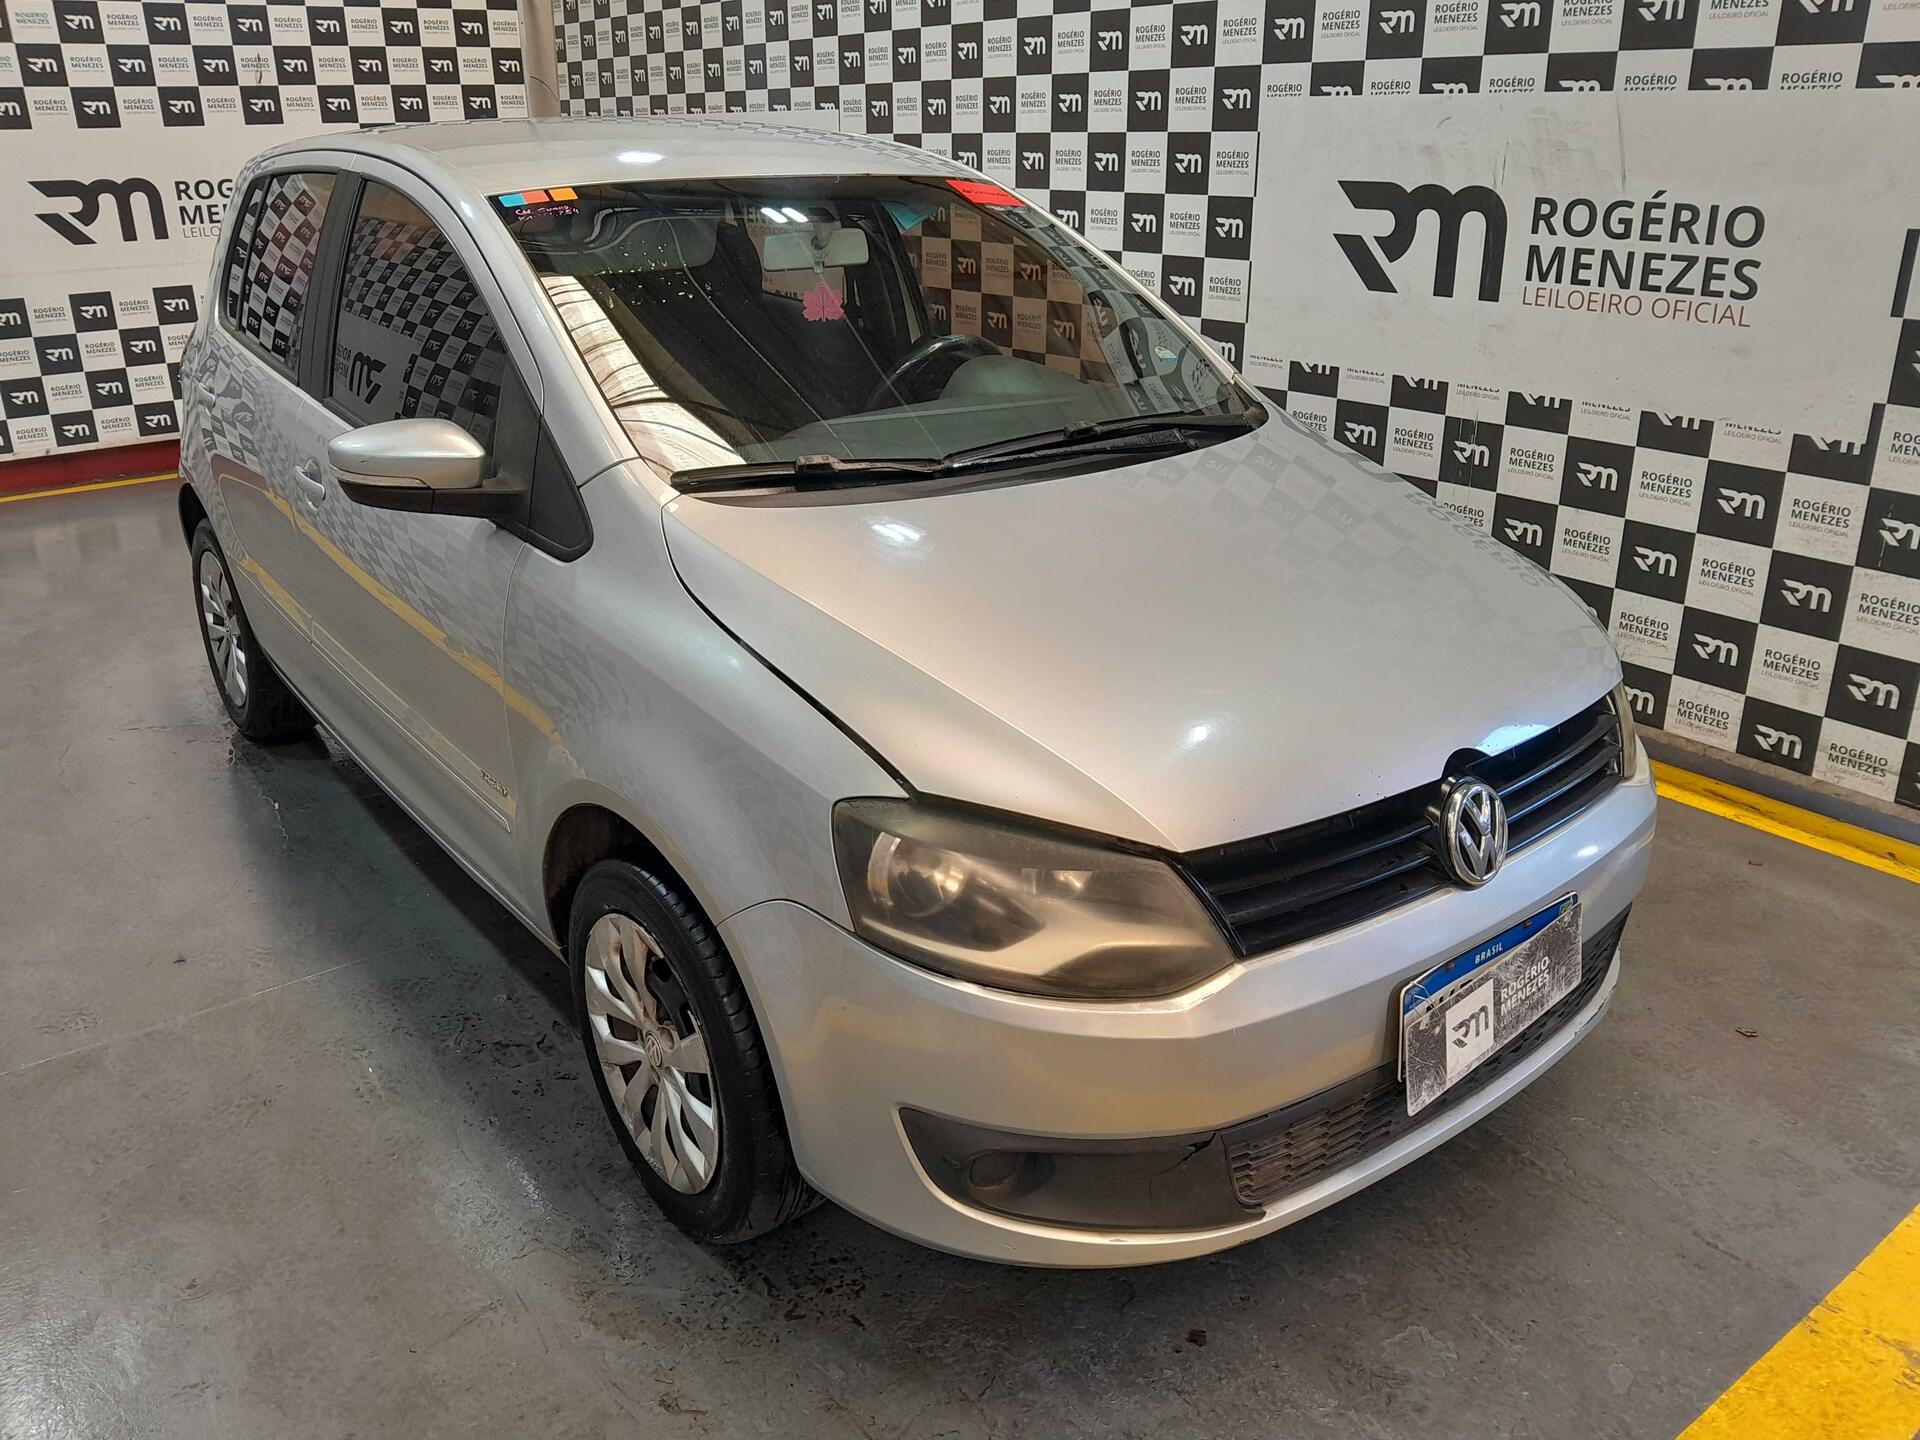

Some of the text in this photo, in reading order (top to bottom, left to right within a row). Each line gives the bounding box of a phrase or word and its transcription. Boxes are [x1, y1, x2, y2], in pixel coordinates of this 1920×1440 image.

[1435, 1, 1478, 13] ROGÉRIO
[1711, 0, 1768, 9] MENEZES
[1323, 9, 1360, 20] ROGÉRIO
[1563, 5, 1612, 17] MENEZES
[1224, 18, 1257, 27] ROGÉRIO
[1434, 13, 1477, 24] MENEZES
[1136, 24, 1165, 34] ROGÉRIO
[1322, 20, 1360, 30] MENEZES
[1058, 30, 1084, 39] ROGÉRIO
[1136, 33, 1165, 42] MENEZES
[1223, 27, 1256, 36] MENEZES
[1058, 39, 1084, 47] MENEZES
[1490, 76, 1535, 87] ROGÉRIO
[1625, 73, 1677, 85] ROGÉRIO
[1782, 70, 1842, 83] ROGÉRIO
[1176, 85, 1206, 95] ROGÉRIO
[1267, 82, 1302, 92] ROGÉRIO
[1371, 81, 1410, 90] ROGÉRIO
[1021, 91, 1046, 99] ROGÉRIO
[1094, 88, 1122, 97] ROGÉRIO
[1021, 100, 1046, 108] MENEZES
[1094, 98, 1122, 106] MENEZES
[1175, 96, 1206, 104] MENEZES
[1056, 148, 1081, 157] ROGÉRIO
[1132, 149, 1160, 158] ROGÉRIO
[1217, 150, 1249, 159] ROGÉRIO
[1216, 160, 1248, 168] MENEZES
[179, 204, 226, 226] ME
[1091, 208, 1118, 217] ROGÉRIO
[1170, 212, 1200, 221] ROGÉRIO
[1091, 217, 1118, 225] MENEZES
[1530, 190, 1766, 248] ROGÉRIO
[1170, 221, 1200, 230] MENEZES
[1524, 244, 1762, 301] MENEZES
[1210, 276, 1241, 286] ROGÉRIO
[1209, 285, 1240, 295] MENEZES
[1522, 286, 1752, 327] LEILOEIRO OFICIAL
[1395, 428, 1434, 441] ROGÉRIO
[1394, 437, 1433, 450] MENEZES
[1510, 448, 1554, 462] ROGÉRIO
[1509, 457, 1553, 472] MENEZES
[1642, 471, 1692, 487] ROGÉRIO
[1640, 481, 1691, 498] MENEZES
[1793, 498, 1851, 517] ROGÉRIO
[1791, 509, 1849, 528] MENEZES
[1564, 528, 1610, 545] ROGÉRIO
[1563, 538, 1609, 555] MENEZES
[1702, 558, 1755, 577] ROGÉRIO
[1701, 568, 1754, 587] MENEZES
[1860, 593, 1920, 614] ROGÉRIO
[1858, 604, 1920, 625] MENEZES
[1621, 612, 1668, 631] ROGÉRIO
[1619, 621, 1668, 641] MENEZES
[1765, 649, 1820, 670] ROGÉRIO
[1763, 659, 1819, 680] MENEZES
[1679, 699, 1729, 720] ROGÉRIO
[1677, 708, 1728, 730] MENEZES
[1830, 743, 1888, 766] ROGÉRIO
[1828, 753, 1886, 777] MENEZES
[1475, 942, 1503, 964] BRASIL
[1501, 956, 1549, 1002] ROGÉRIO
[1500, 969, 1549, 1017] MENEZES
